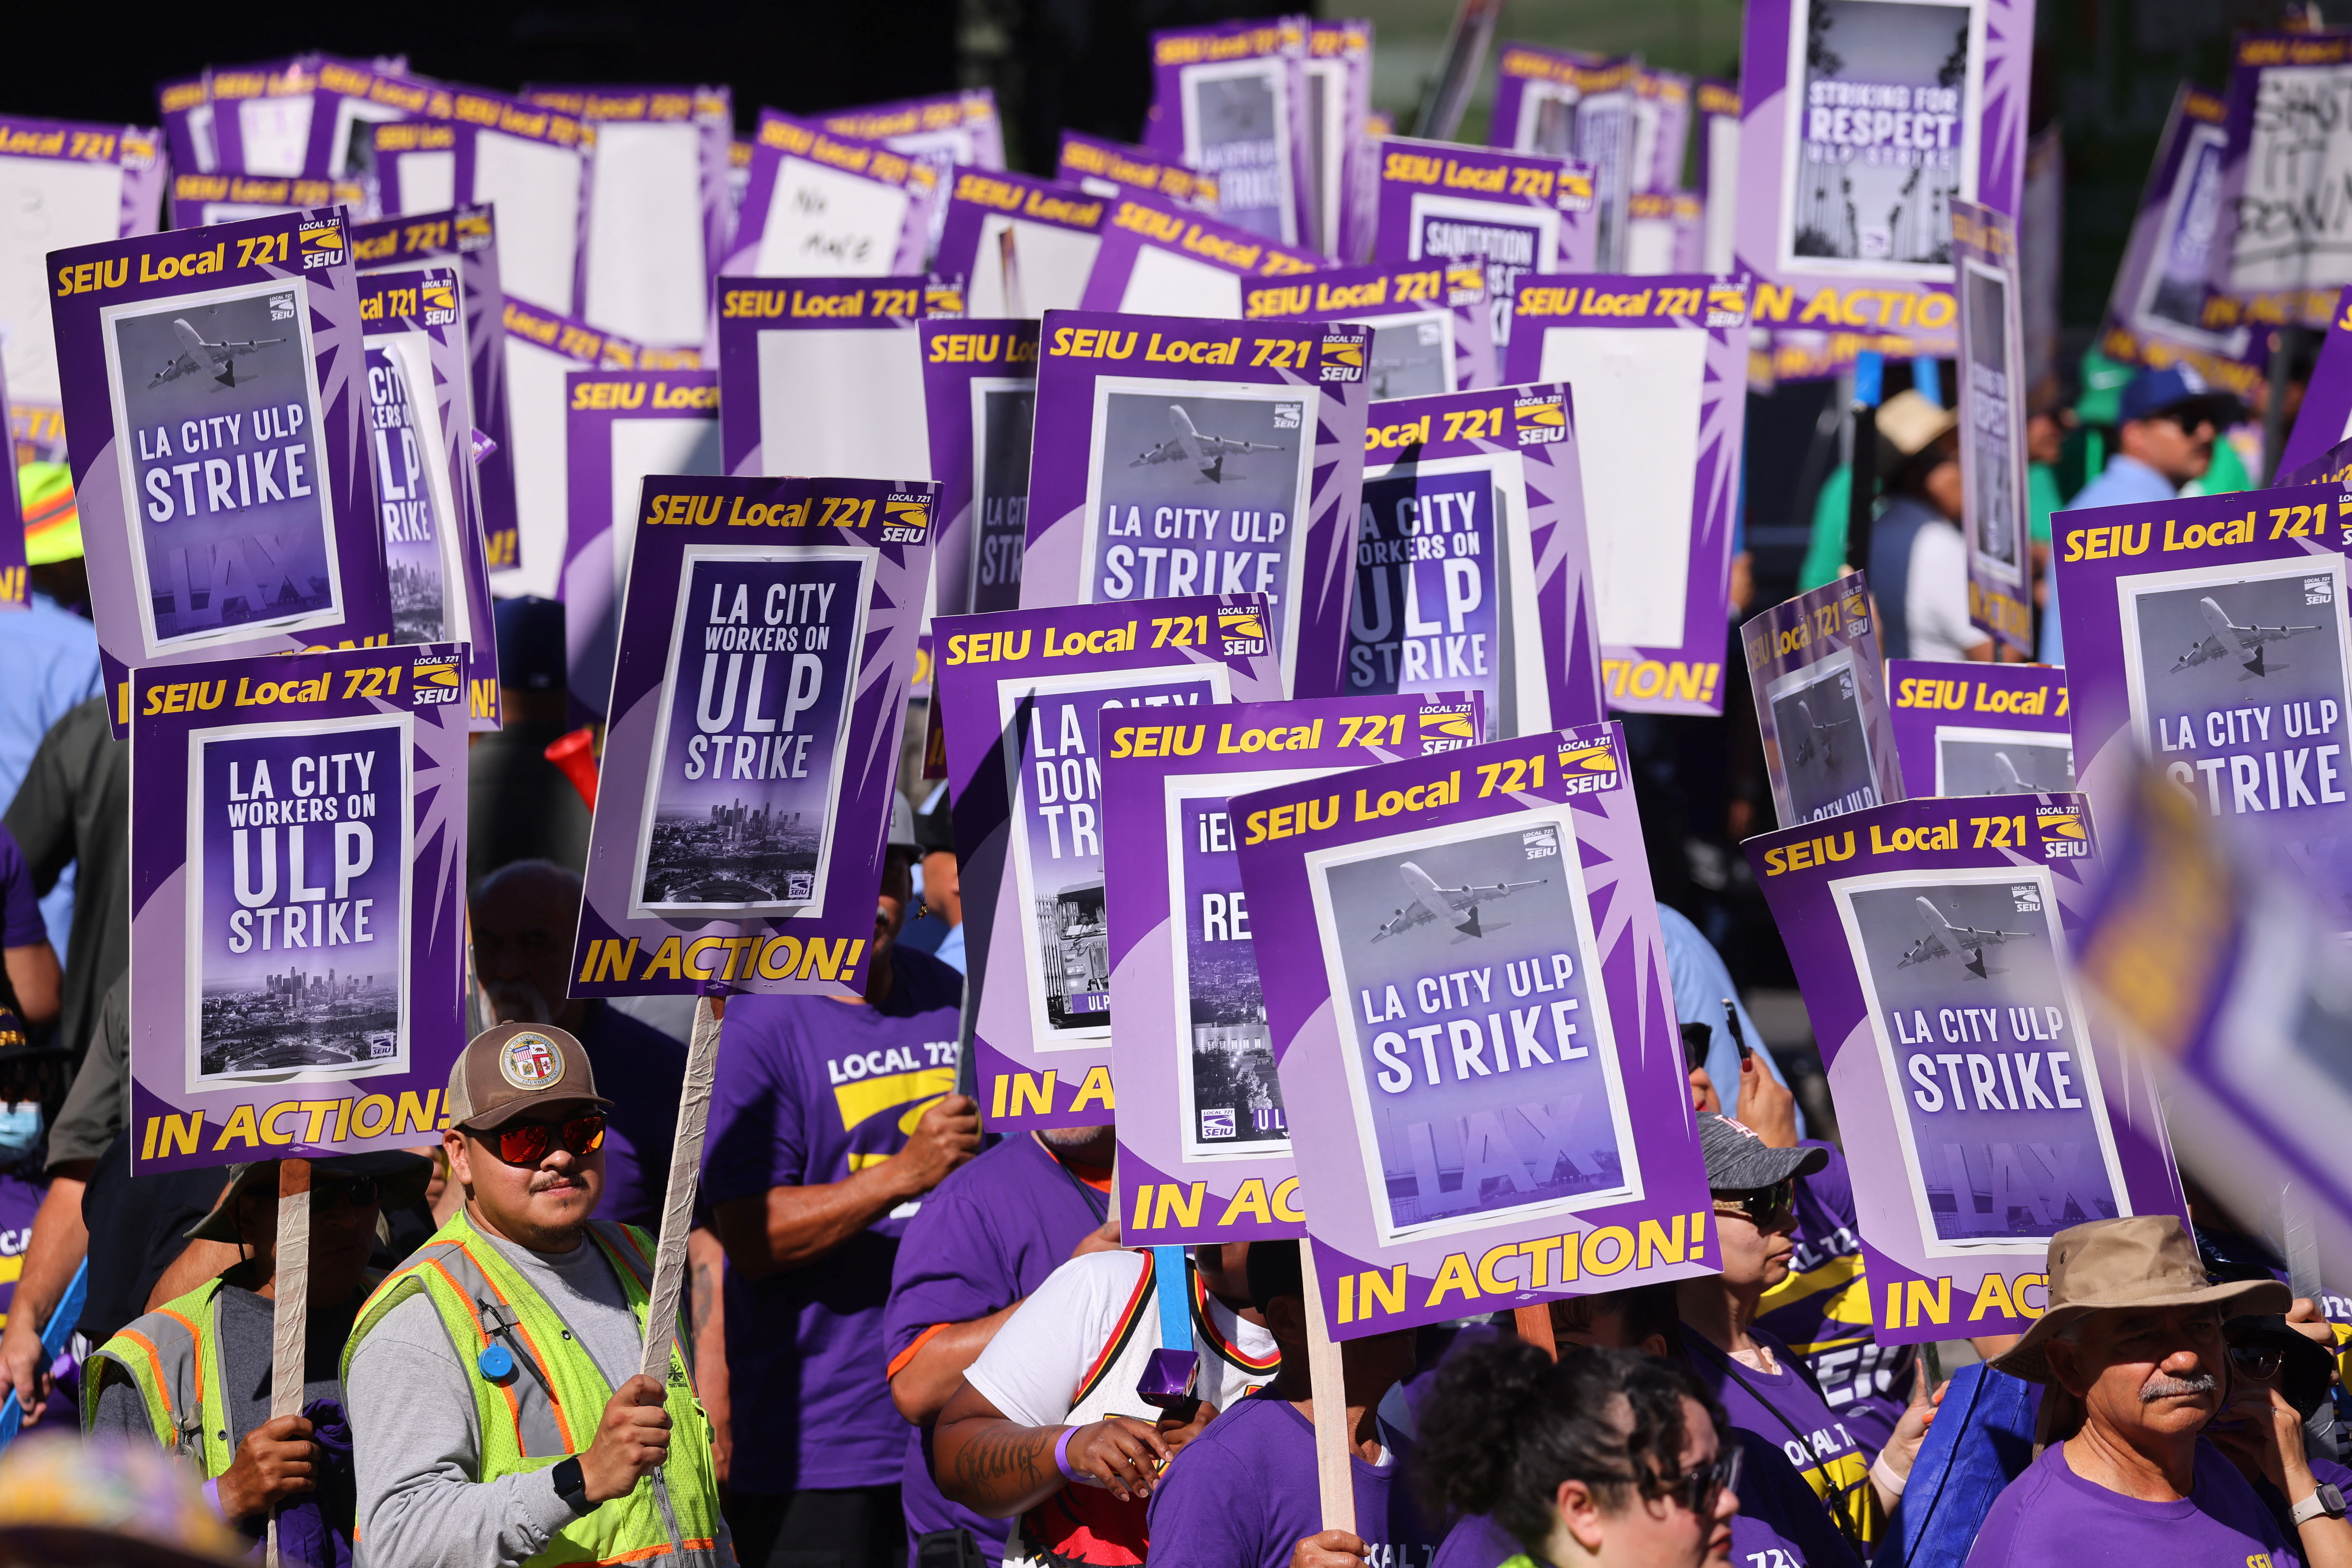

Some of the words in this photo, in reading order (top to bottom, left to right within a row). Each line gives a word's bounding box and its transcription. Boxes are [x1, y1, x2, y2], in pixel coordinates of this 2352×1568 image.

[69, 132, 115, 159] 721
[1809, 111, 1959, 149] RESPECT
[954, 174, 1020, 211] SEIU
[1025, 188, 1104, 228] Local
[299, 221, 324, 231] LOCAL
[324, 217, 340, 226] 721
[408, 224, 447, 249] 721
[1113, 202, 1185, 243] SEIU
[1185, 223, 1262, 270] Local
[58, 258, 128, 296] SEIU
[140, 243, 224, 282] Local
[238, 233, 288, 267] 721
[302, 250, 343, 269] SEIU
[389, 289, 415, 316] 721
[725, 292, 784, 315] SEIU
[793, 292, 863, 315] Local
[874, 291, 917, 315] 721
[1248, 288, 1310, 317] SEIU
[1318, 279, 1386, 309] Local
[1397, 273, 1439, 300] 721
[1518, 289, 1577, 313] SEIU
[1582, 290, 1650, 314] Local
[1656, 290, 1701, 313] 721
[271, 309, 294, 321] SEIU
[424, 306, 454, 326] SEIU
[930, 336, 999, 361] SEIU
[1050, 328, 1138, 359] SEIU
[1146, 334, 1241, 364] Local
[1251, 339, 1311, 367] 721
[1322, 335, 1347, 343] LOCAL
[1349, 335, 1364, 343] 721
[1319, 367, 1361, 381] SEIU
[571, 381, 647, 411] SEIU
[1513, 397, 1545, 408] LOCAL
[139, 426, 172, 460] LA
[182, 413, 241, 453] CITY
[253, 404, 303, 441] ULP
[1274, 418, 1300, 429] SEIU
[1444, 408, 1503, 441] 721
[1517, 425, 1565, 445] SEIU
[146, 440, 311, 522] STRIKE
[914, 493, 931, 503] 721
[647, 495, 723, 525] SEIU
[729, 497, 812, 526] Local
[818, 498, 876, 527] 721
[1108, 505, 1141, 536] LA
[1155, 507, 1220, 540] CITY
[1231, 511, 1285, 542] ULP
[1396, 490, 1477, 537] CITY
[880, 528, 925, 542] SEIU
[1453, 532, 1480, 556] ON
[2065, 523, 2151, 562] SEIU
[2164, 512, 2256, 551] Local
[2269, 504, 2327, 539] 721
[168, 528, 317, 629] LAX
[1099, 545, 1280, 608] STRIKE
[710, 584, 747, 624] LA
[765, 583, 836, 625] CITY
[1246, 606, 1259, 614] 721
[1353, 558, 1483, 644] ULP
[2305, 594, 2331, 605] SEIU
[705, 627, 798, 651] WORKERS
[805, 626, 829, 650] ON
[947, 630, 1031, 665] SEIU
[1044, 621, 1137, 657] Local
[1152, 616, 1207, 648] 721
[1773, 617, 1811, 659] Local
[1814, 601, 1840, 641] 721
[1848, 618, 1868, 638] SEIU
[414, 657, 442, 665] LOCAL
[1224, 639, 1263, 655] SEIU
[1349, 633, 1489, 688] STRIKE
[144, 680, 226, 715] SEIU
[235, 673, 331, 706] Local
[343, 667, 402, 699] 721
[413, 688, 458, 705] SEIU
[697, 654, 822, 733] ULP
[1419, 705, 1452, 714] LOCAL
[1454, 703, 1471, 713] 721
[1898, 679, 1967, 709] SEIU
[1975, 684, 2047, 714] Local
[1031, 704, 1086, 758] LA
[1111, 725, 1206, 758] SEIU
[1218, 719, 1323, 753] Local
[1338, 715, 1405, 747] 721
[1558, 740, 1591, 752] LOCAL
[1592, 735, 1611, 746] 721
[2160, 716, 2196, 751] LA
[2207, 707, 2270, 746] CITY
[2284, 700, 2337, 737] ULP
[230, 760, 274, 801] LA
[292, 751, 375, 797] CITY
[685, 735, 813, 780] STRIKE
[1563, 772, 1617, 795] SEIU
[2166, 744, 2346, 816] STRIKE
[228, 797, 337, 827] WORKERS
[348, 793, 375, 818] ON
[1246, 795, 1339, 844] SEIU
[1355, 771, 1460, 821] Local
[1478, 755, 1544, 797] 721
[1525, 846, 1557, 859] SEIU
[1765, 831, 1855, 876] SEIU
[1871, 819, 1958, 854] Local
[1971, 816, 2026, 848] 721
[2045, 842, 2087, 858] SEIU
[233, 821, 373, 912] ULP
[2017, 903, 2040, 912] SEIU
[229, 899, 377, 958] STRIKE
[580, 939, 639, 982] IN
[641, 936, 865, 980] ACTION!
[1088, 993, 1109, 1012] ULP
[1362, 985, 1406, 1024] LA
[1417, 967, 1491, 1013] CITY
[1506, 954, 1572, 997] ULP
[532, 1036, 554, 1049] ANGELES
[1370, 994, 1588, 1093] STRIKE
[1894, 1010, 1934, 1044] LA
[1940, 1009, 1998, 1042] CITY
[2009, 1007, 2063, 1041] ULP
[372, 1047, 391, 1056] SEIU
[828, 1046, 920, 1084] LOCAL
[549, 1071, 558, 1080] 1781
[992, 1071, 1056, 1117] IN
[1909, 1052, 2082, 1112] STRIKE
[141, 1112, 204, 1159] IN
[213, 1089, 451, 1150] ACTION!
[1204, 1127, 1234, 1137] SEIU
[1407, 1093, 1605, 1211] LAX
[1943, 1140, 2105, 1232] LAX
[1133, 1183, 1205, 1229] IN
[1338, 1265, 1406, 1323] IN
[1425, 1212, 1705, 1306] ACTION!
[1886, 1278, 1950, 1329] IN
